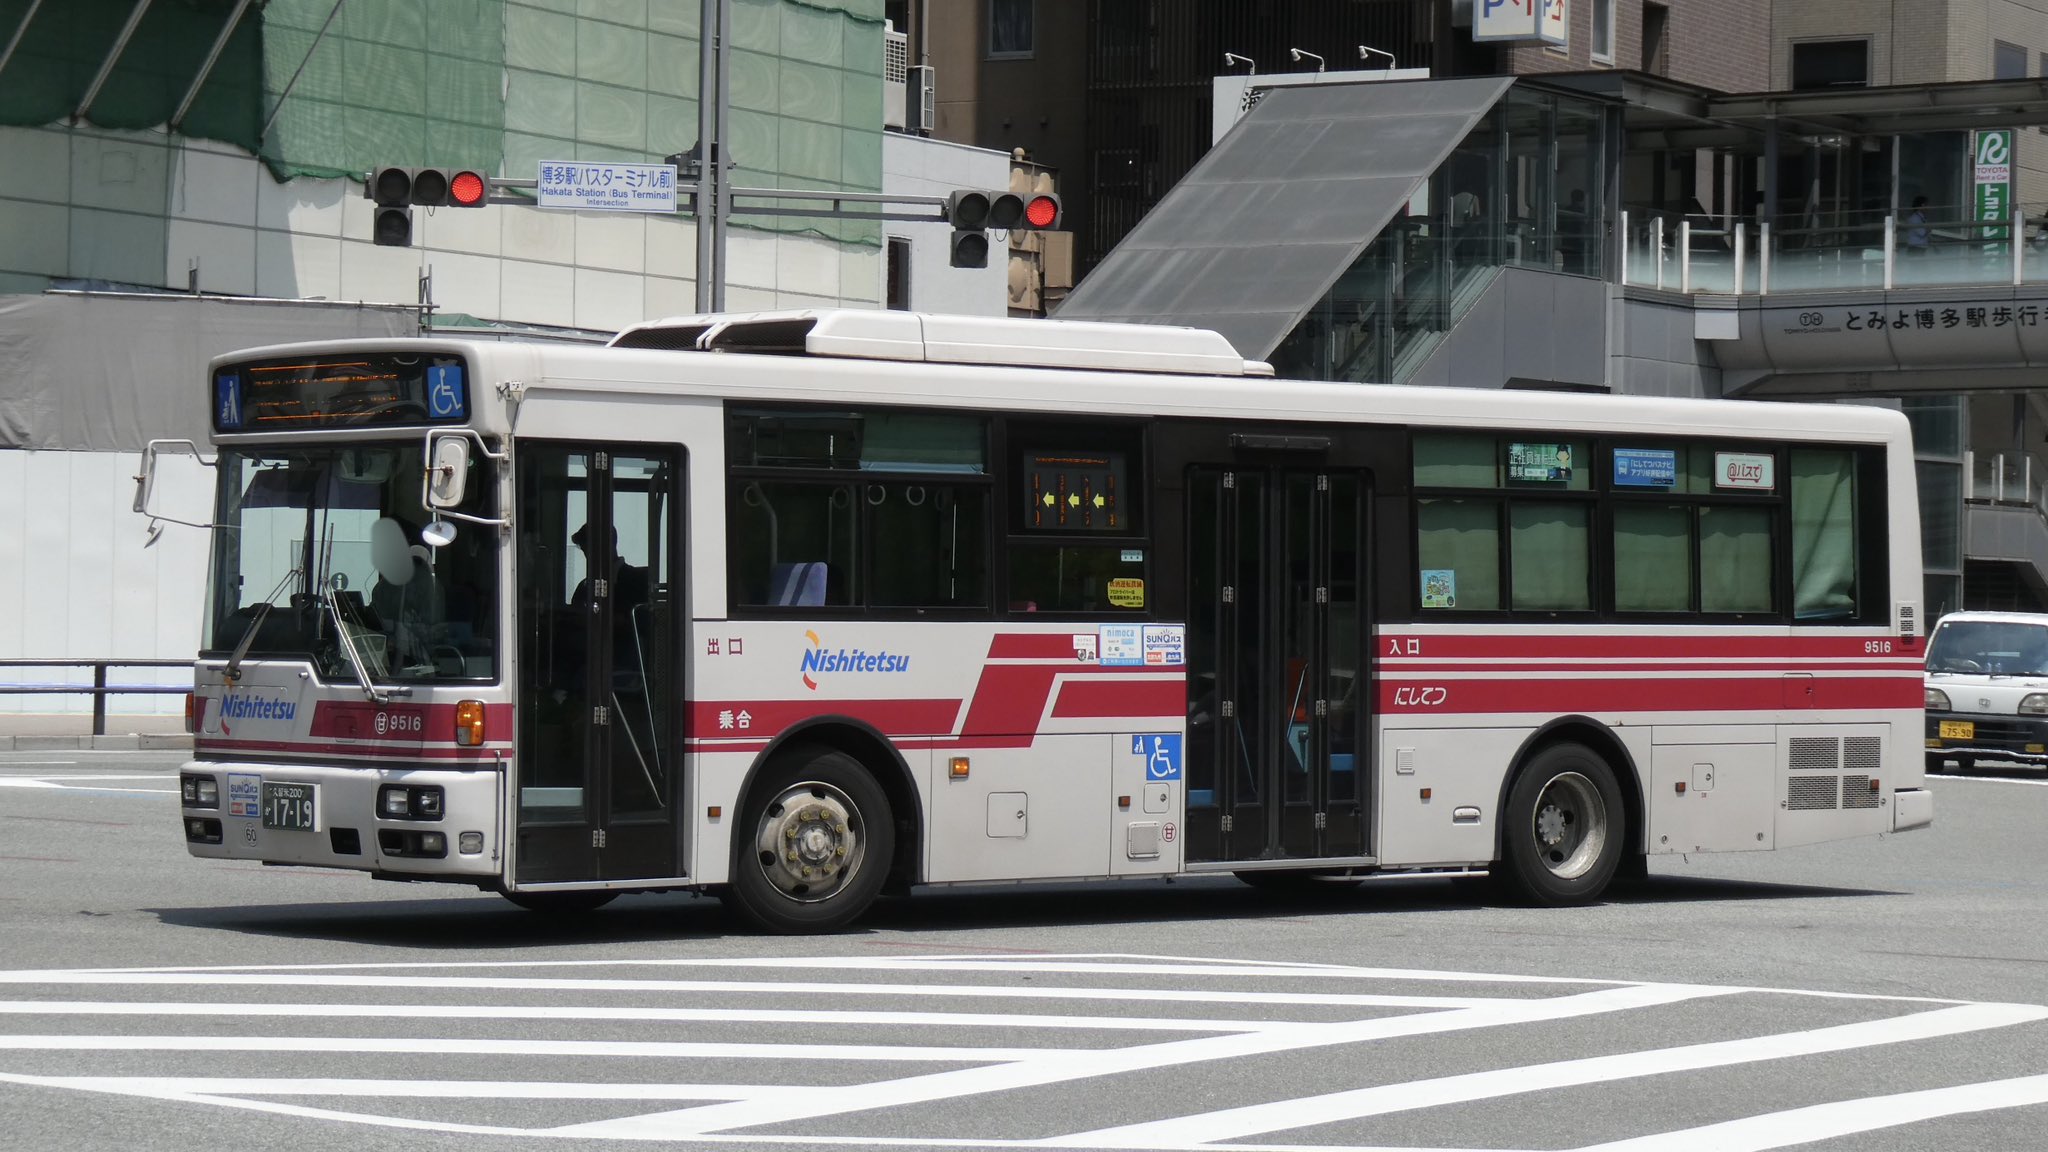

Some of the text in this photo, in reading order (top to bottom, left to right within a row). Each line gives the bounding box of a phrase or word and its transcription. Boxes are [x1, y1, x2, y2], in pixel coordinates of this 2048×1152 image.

[1977, 166, 2008, 174] TOYOTA
[541, 187, 673, 200] Hakata Station (Bus Terminal)
[586, 198, 629, 206] Intersection
[1846, 306, 2048, 331] とみよ博多駅歩行
[1106, 627, 1135, 638] nimoca
[1864, 641, 1891, 654] 9516
[800, 647, 910, 672] Nishitetsu
[1394, 687, 1447, 706] にしてつ
[219, 693, 296, 720] Nishitetsu
[390, 715, 421, 731] 9516
[718, 710, 752, 730] 乗合
